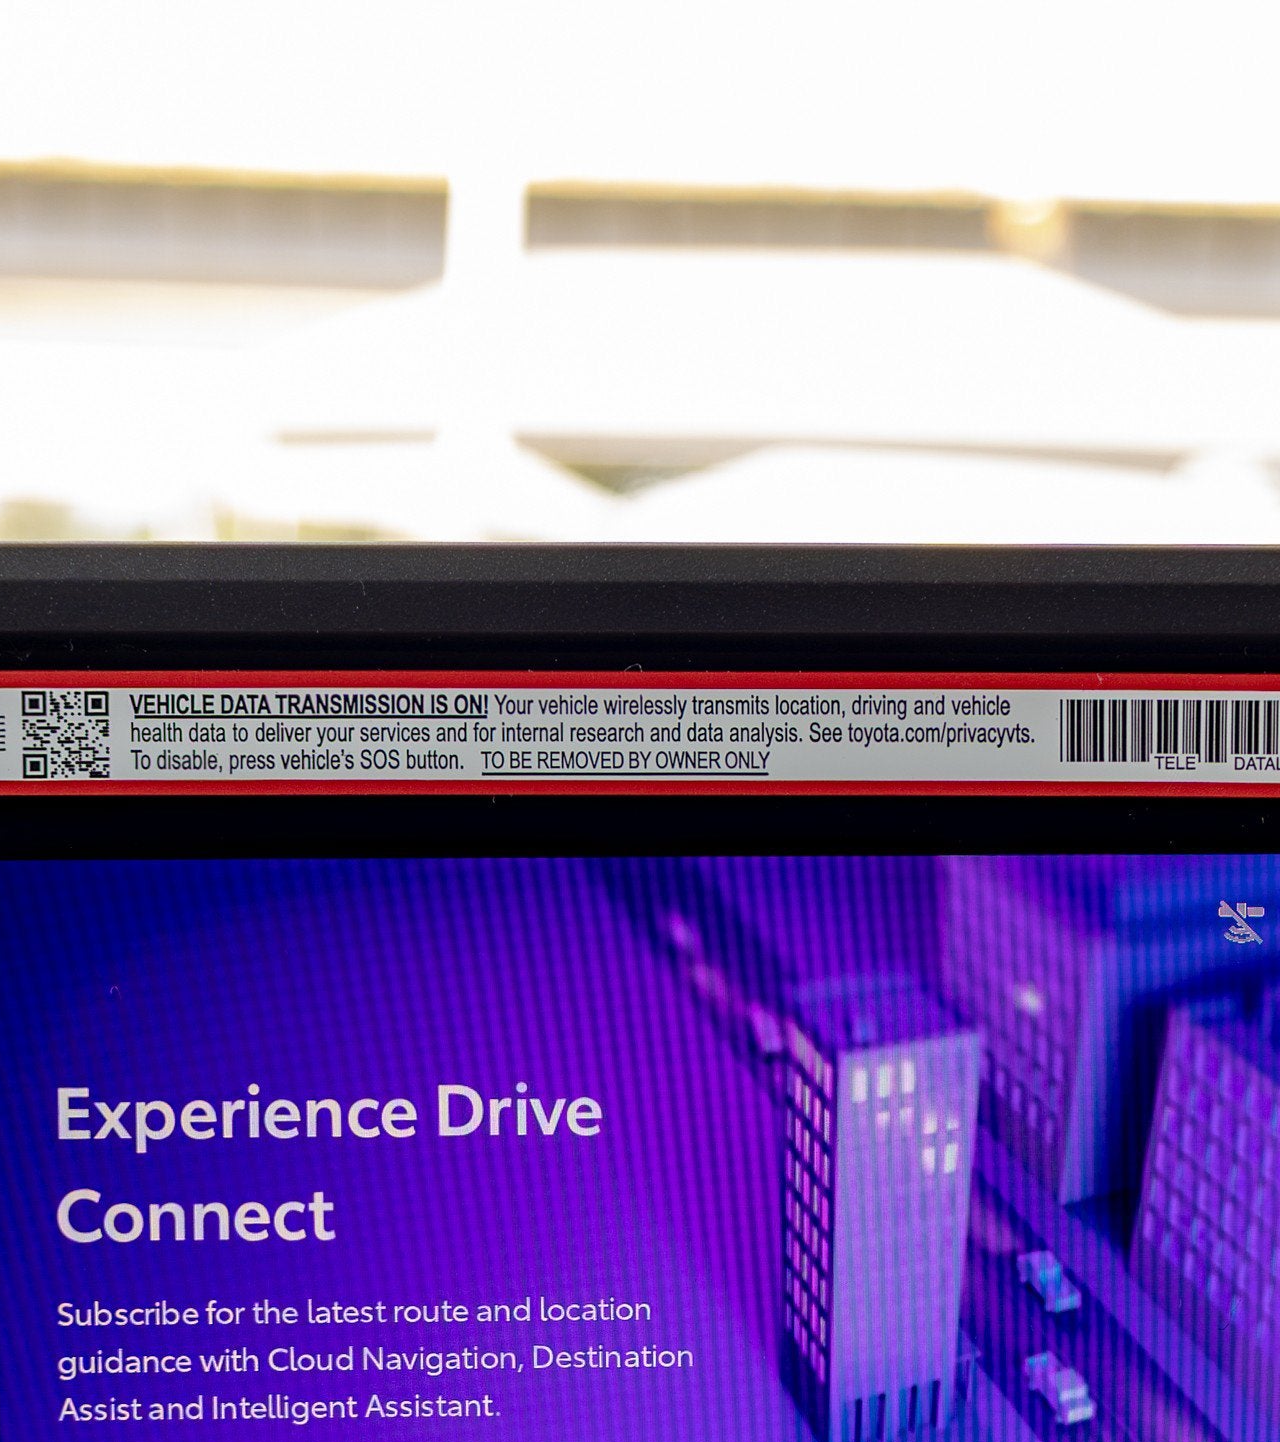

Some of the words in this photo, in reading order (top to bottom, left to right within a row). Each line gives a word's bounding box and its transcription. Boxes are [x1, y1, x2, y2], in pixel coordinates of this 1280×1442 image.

[128, 693, 215, 713] VEHICLE
[220, 694, 271, 713] DATA
[274, 693, 425, 713] TRANSMISSION
[430, 693, 449, 713] IS
[453, 693, 489, 713] ON!
[493, 693, 534, 715] Your
[538, 694, 599, 715] vehicle
[603, 694, 688, 720] wirelessly
[691, 694, 770, 716] transmits
[775, 694, 846, 719] location,
[851, 694, 908, 720] driving
[913, 694, 946, 716] and
[951, 694, 1011, 716] vehicle
[130, 721, 183, 743] health
[188, 721, 226, 743] data
[232, 722, 249, 743] to
[255, 721, 313, 743] deliver
[316, 726, 356, 748] your
[359, 721, 431, 743] services
[436, 721, 468, 743] and
[472, 721, 497, 743] for
[501, 721, 564, 743] internal
[569, 721, 645, 743] research
[649, 721, 681, 743] and
[686, 721, 724, 743] data
[729, 721, 803, 748] analysis.
[808, 721, 843, 743] See
[847, 721, 1035, 749] toyota.com/privacyvts.
[130, 749, 152, 771] To
[156, 749, 223, 773] disable,
[229, 754, 276, 775] press
[359, 748, 401, 770] SOS
[406, 748, 464, 770] button.
[480, 750, 505, 770] TO
[509, 750, 533, 769] BE
[537, 750, 625, 770] REMOVED
[628, 750, 652, 770] BY
[655, 750, 722, 770] OWNER
[724, 750, 771, 770] ONLY
[1154, 755, 1197, 771] TELE
[57, 1083, 418, 1154] Experience
[438, 1082, 602, 1137] Drive
[57, 1189, 336, 1243] Connect
[58, 1300, 199, 1327] Subscribe
[205, 1299, 246, 1325] for
[252, 1299, 299, 1324] the
[308, 1298, 387, 1324] latest
[394, 1300, 469, 1323] route
[476, 1296, 531, 1322] and
[540, 1296, 651, 1322] location
[58, 1348, 192, 1380] guidance
[199, 1346, 259, 1373] with
[268, 1345, 354, 1372] Cloud
[363, 1345, 524, 1376] Navigation,
[533, 1344, 693, 1369] Destination
[58, 1397, 143, 1422] Assist
[148, 1394, 204, 1421] and
[213, 1394, 359, 1425] Intelligent
[364, 1393, 500, 1418] Assistant.
